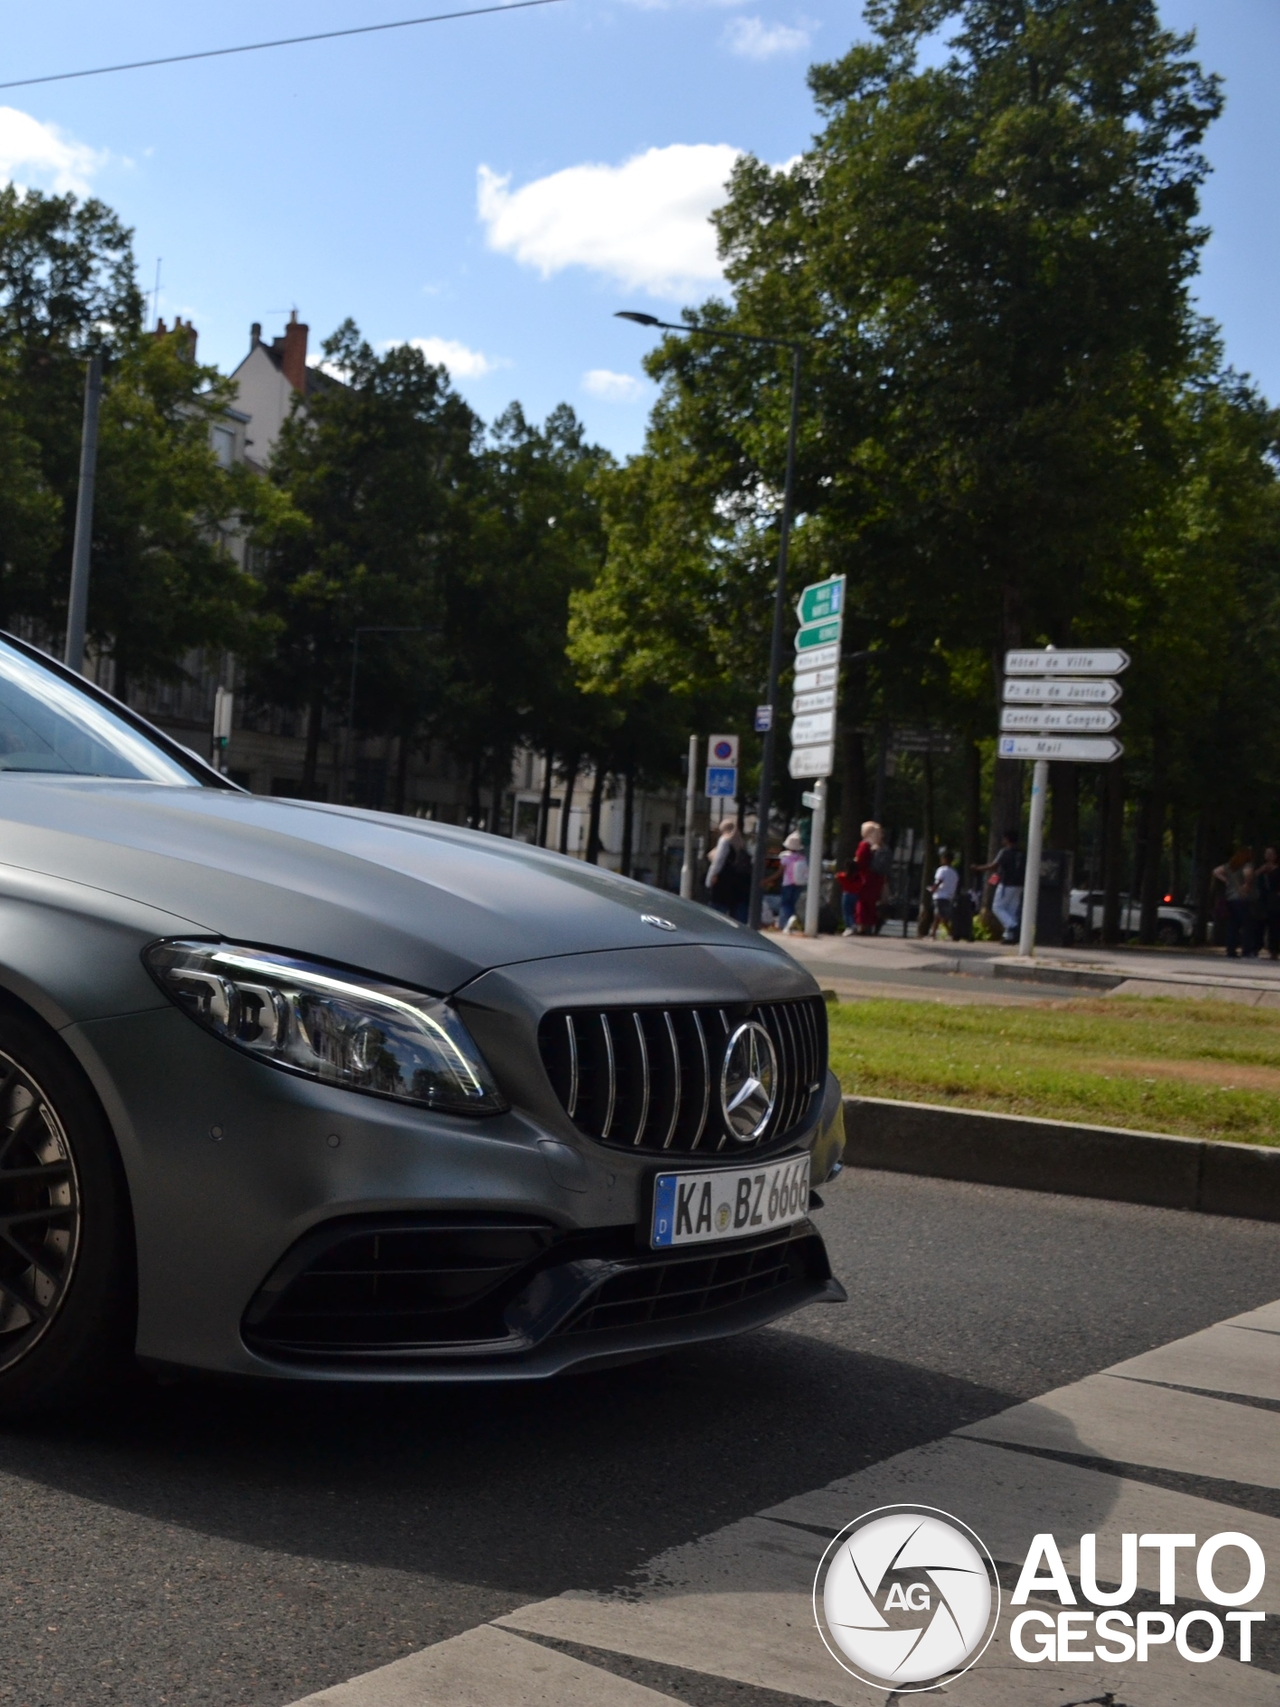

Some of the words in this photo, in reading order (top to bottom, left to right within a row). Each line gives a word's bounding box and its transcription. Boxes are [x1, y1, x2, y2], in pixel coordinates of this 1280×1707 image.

[1010, 656, 1039, 667] Hôtel
[1045, 657, 1059, 667] de
[1067, 657, 1093, 668] Ville
[1047, 685, 1060, 696] de
[1067, 686, 1106, 697] Justice
[1006, 713, 1039, 723] Centre
[1044, 714, 1060, 724] des
[1036, 743, 1062, 753] Mail
[675, 1181, 712, 1236] KA
